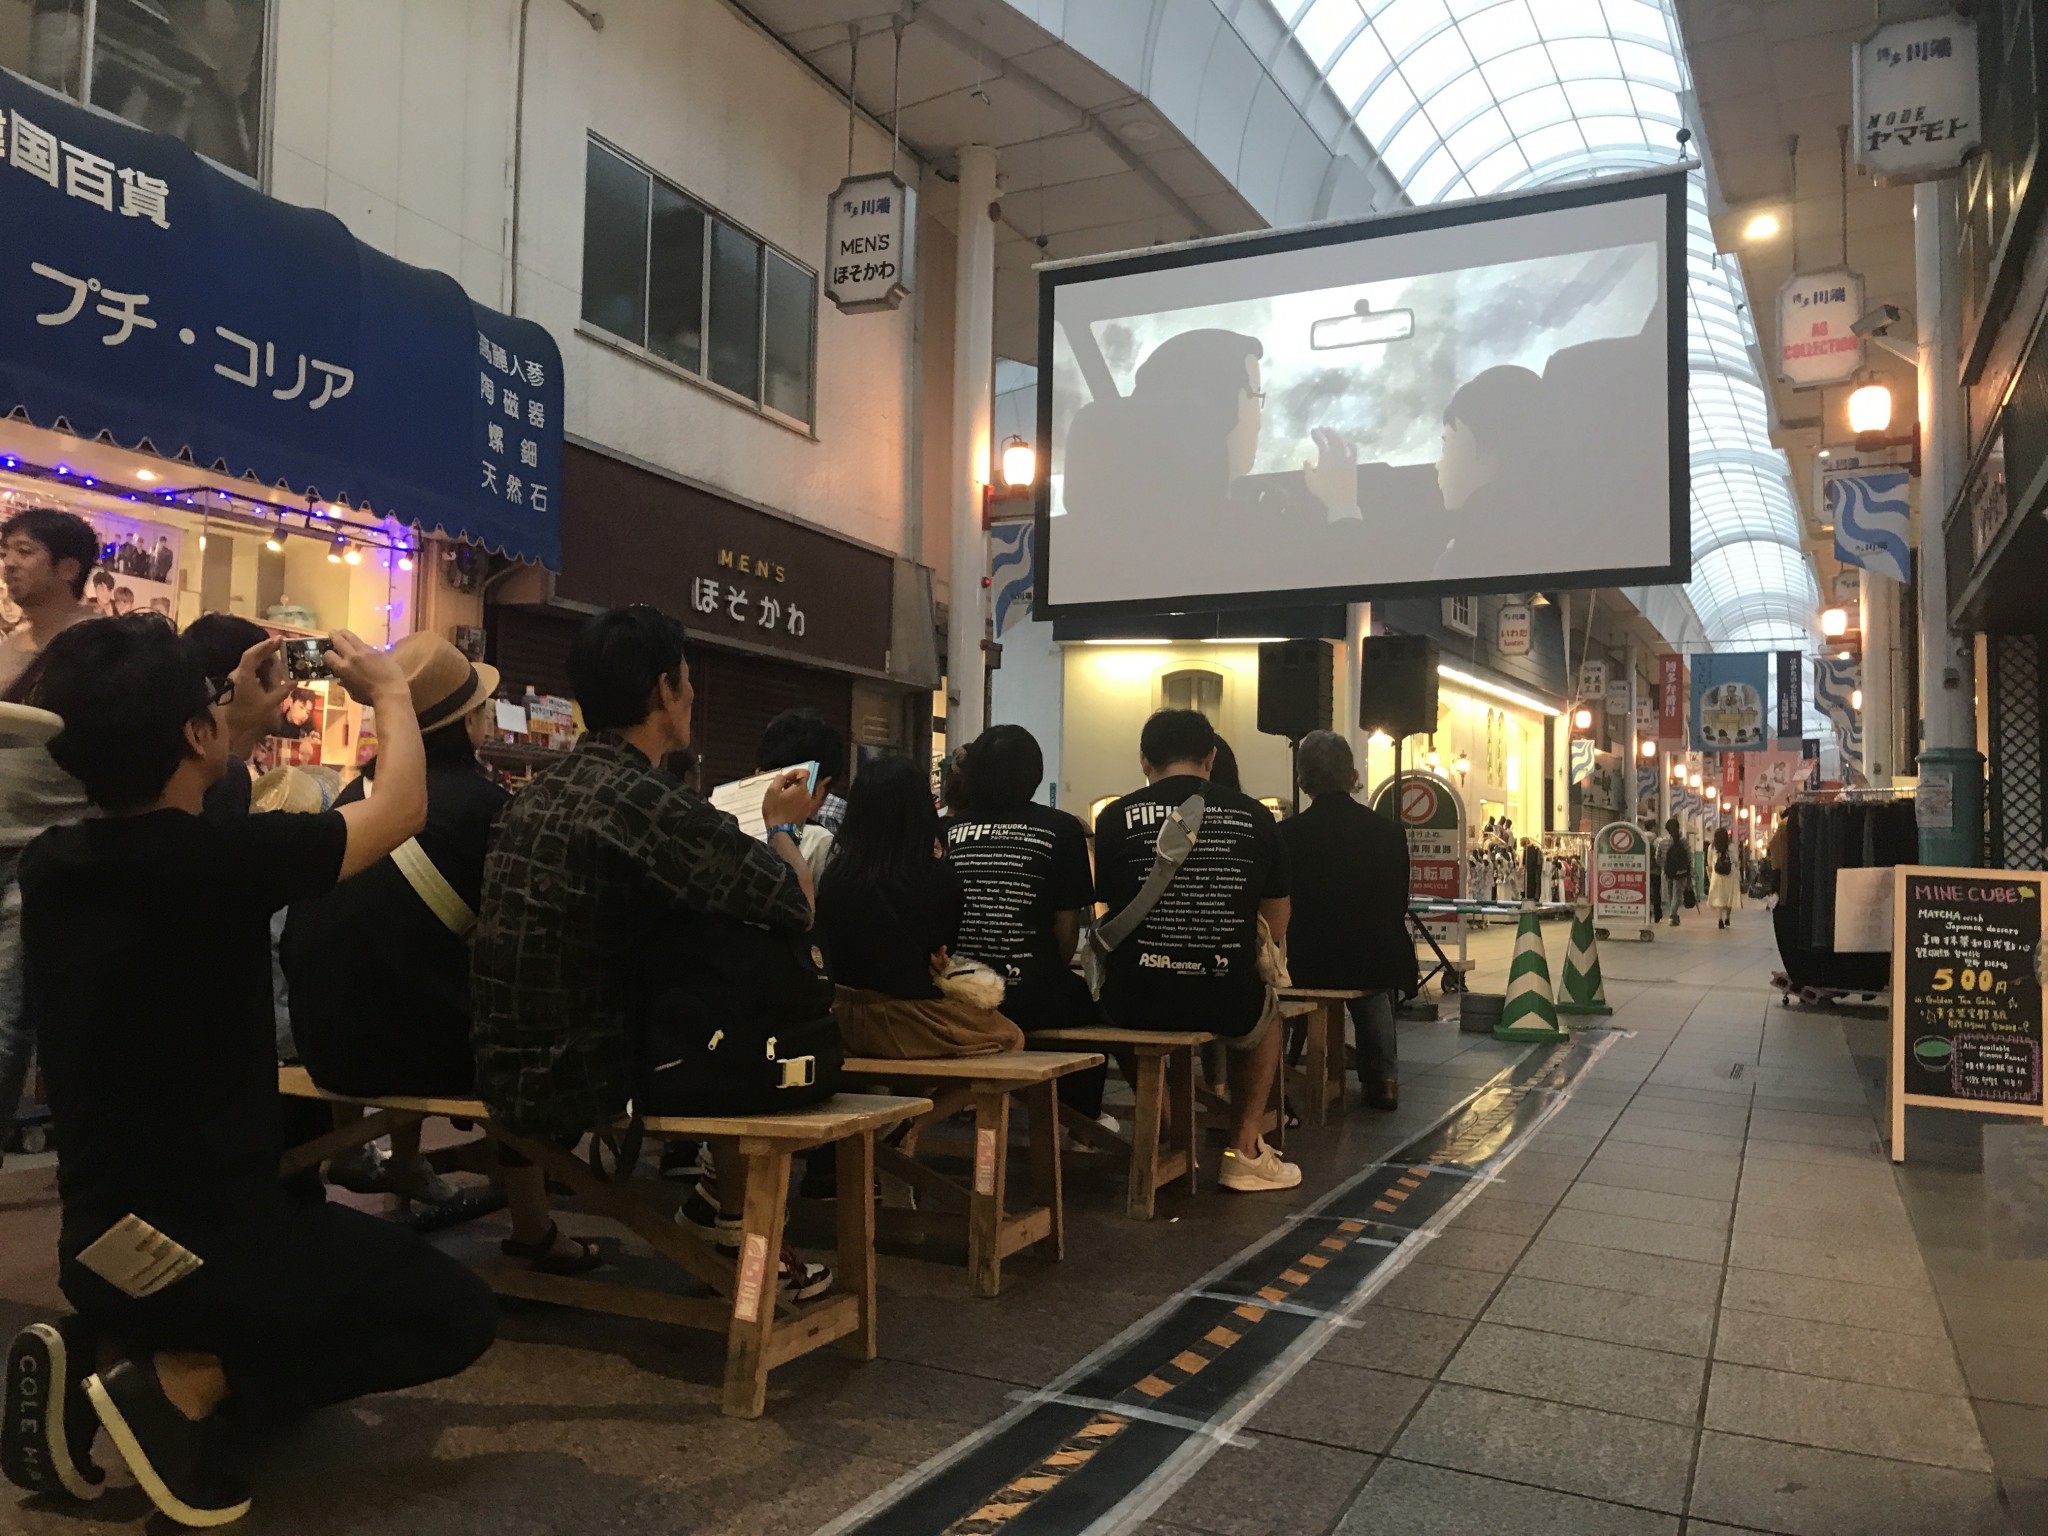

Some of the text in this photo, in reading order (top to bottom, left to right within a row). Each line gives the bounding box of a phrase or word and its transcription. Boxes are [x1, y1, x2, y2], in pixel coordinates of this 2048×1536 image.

[1867, 106, 1926, 129] MODE
[1867, 117, 1968, 151] ヤマモト
[0, 107, 171, 230] 国百貨
[840, 234, 890, 255] MEN'S
[833, 261, 895, 284] ほそかわ
[31, 261, 355, 411] プチ・コリア
[1784, 336, 1858, 359] COLLECTION
[480, 371, 545, 429] 陶磁器
[480, 460, 548, 512] 天然石
[718, 548, 785, 582] MEN'S
[691, 576, 805, 636] ほそかわ
[1412, 866, 1454, 881] 自転車
[1915, 884, 2018, 903] MINE CUBE
[1918, 909, 1984, 923] MATCHA with
[1945, 921, 1982, 933] Japanese
[1139, 952, 1203, 970] ASIA center
[1925, 995, 1953, 1005] Golden
[1957, 995, 1972, 1005] Tea
[1963, 1042, 2010, 1052] Also available
[1979, 1051, 2003, 1059] Kimono
[19, 1355, 38, 1433] COLE
